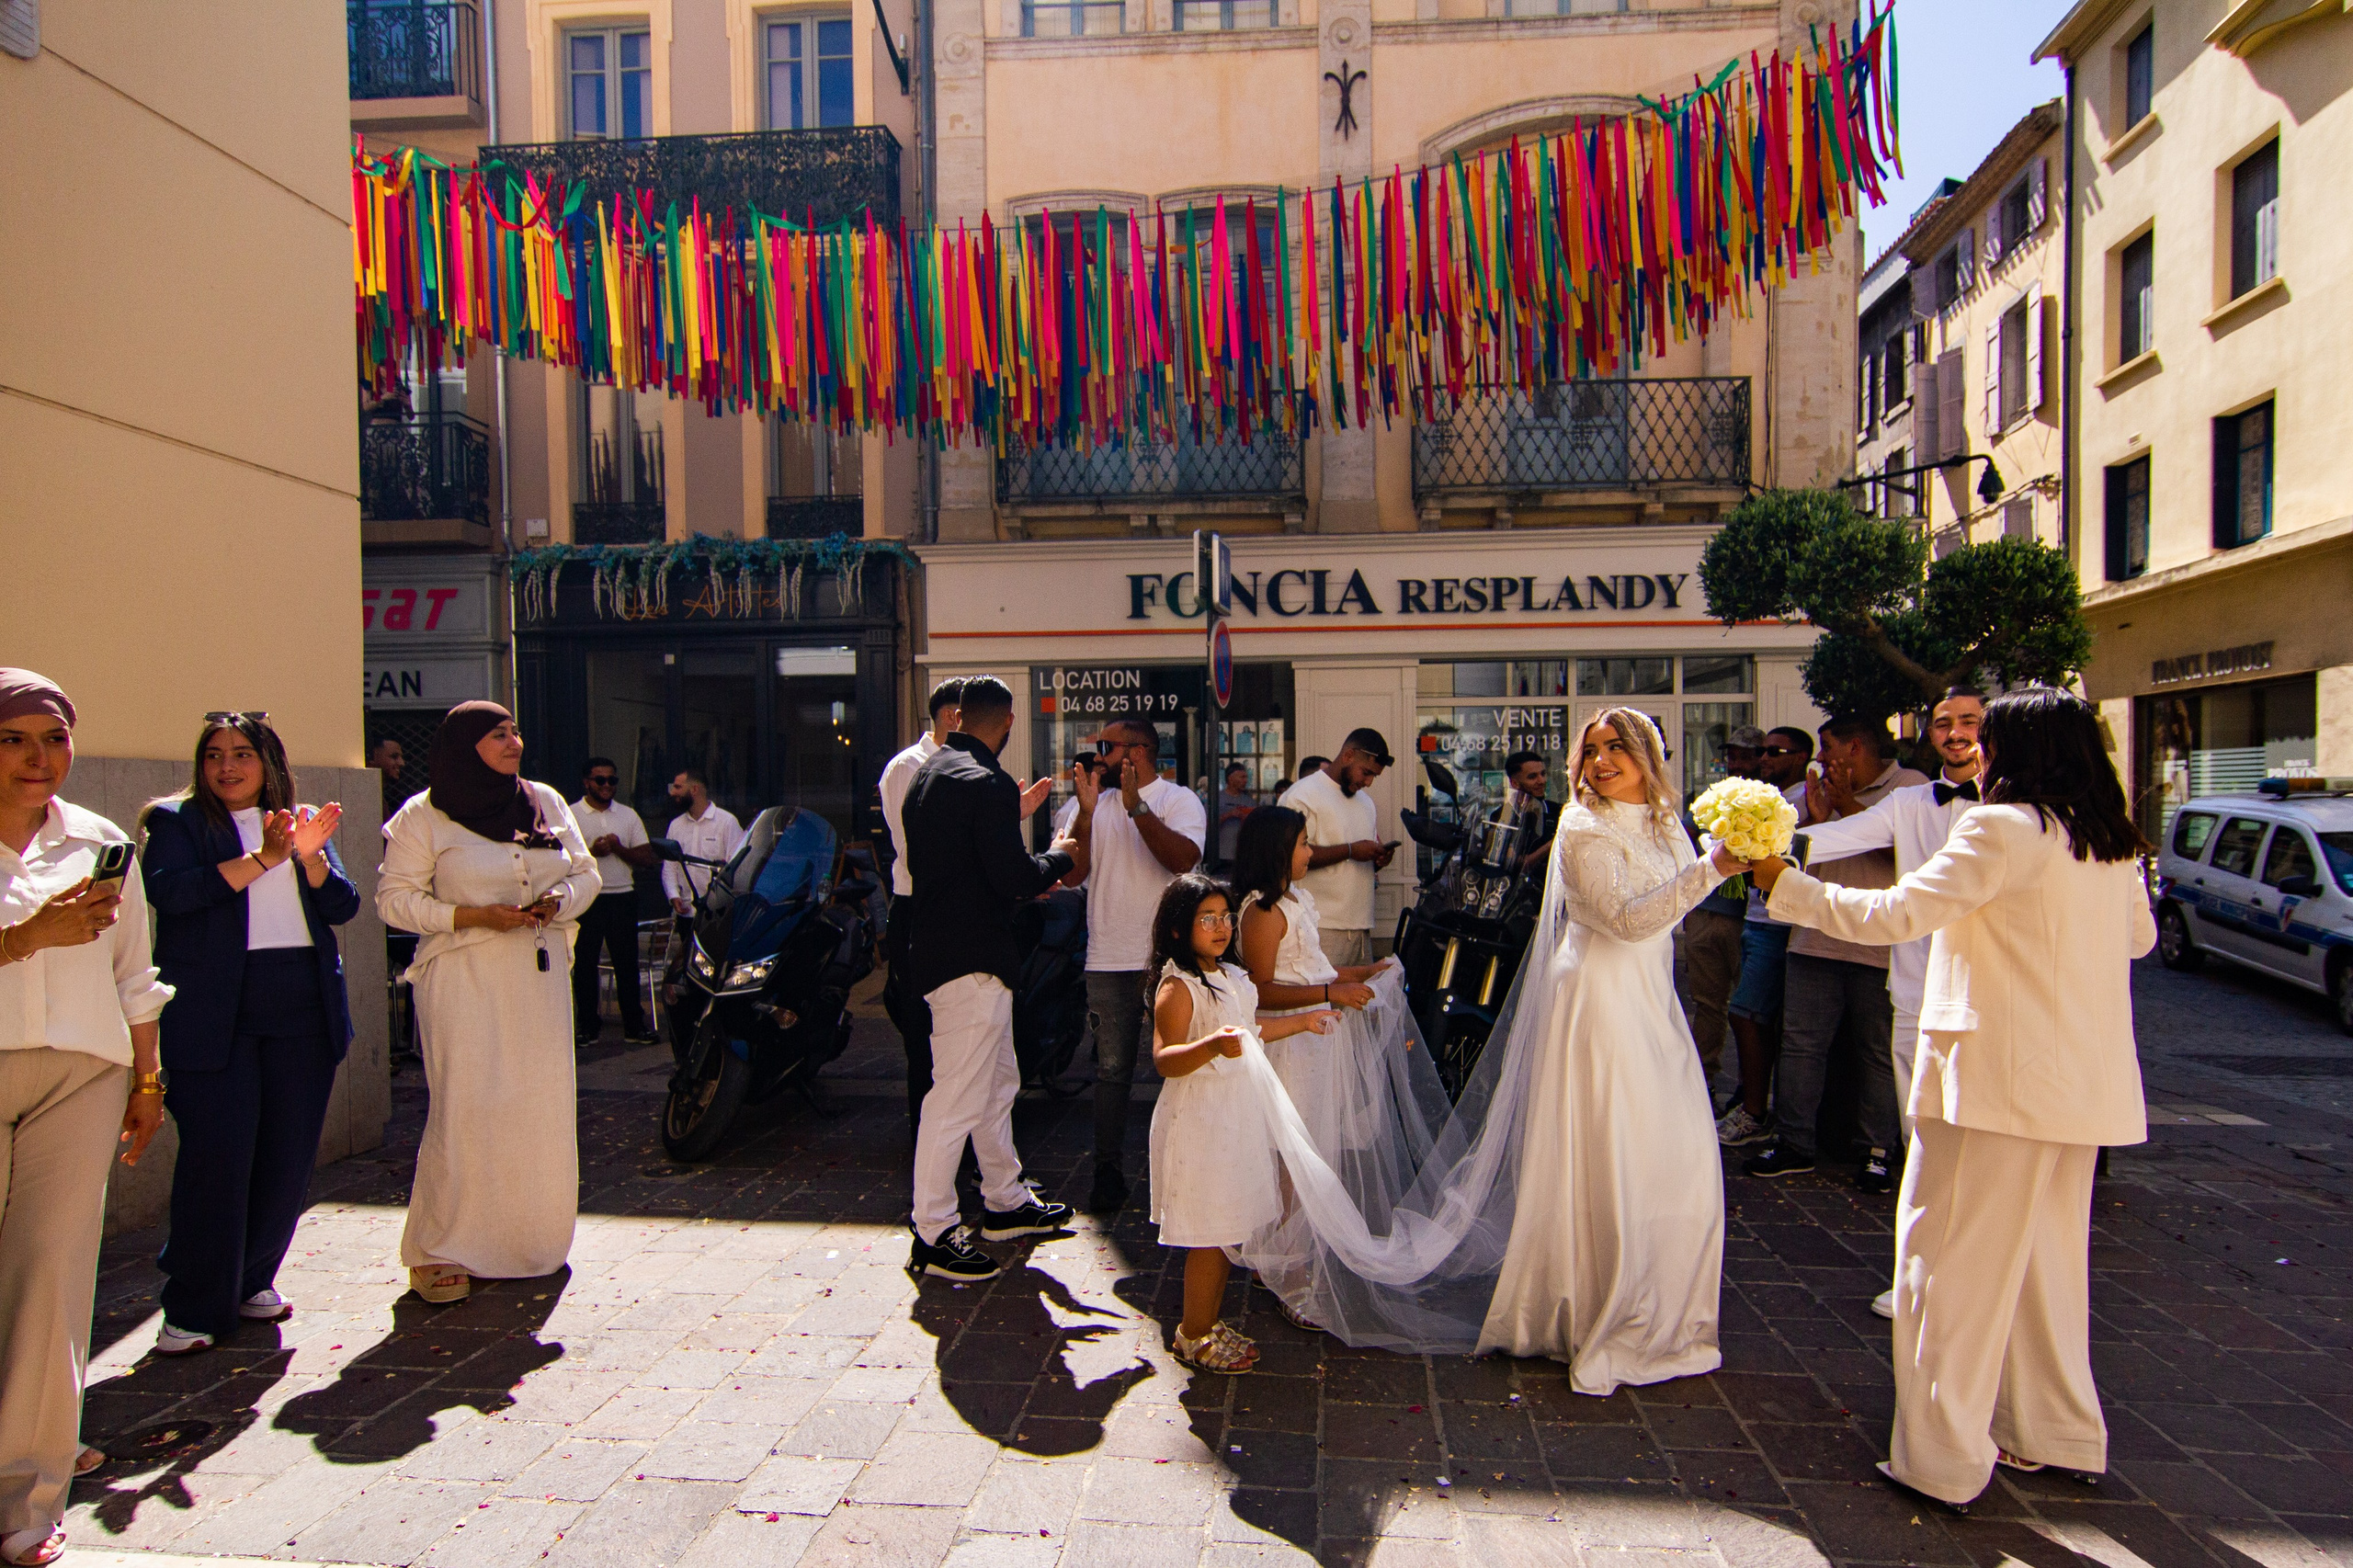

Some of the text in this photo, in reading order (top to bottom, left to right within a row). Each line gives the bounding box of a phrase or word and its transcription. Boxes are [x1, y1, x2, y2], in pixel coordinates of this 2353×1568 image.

[1126, 567, 1689, 619] FONCIA RESPLANDY
[1039, 670, 1141, 690] LOCATION
[1061, 694, 1178, 713] 04 68 25 19 19
[1493, 709, 1563, 729] VENTE
[1440, 733, 1562, 752] 04 68 25 19 18
